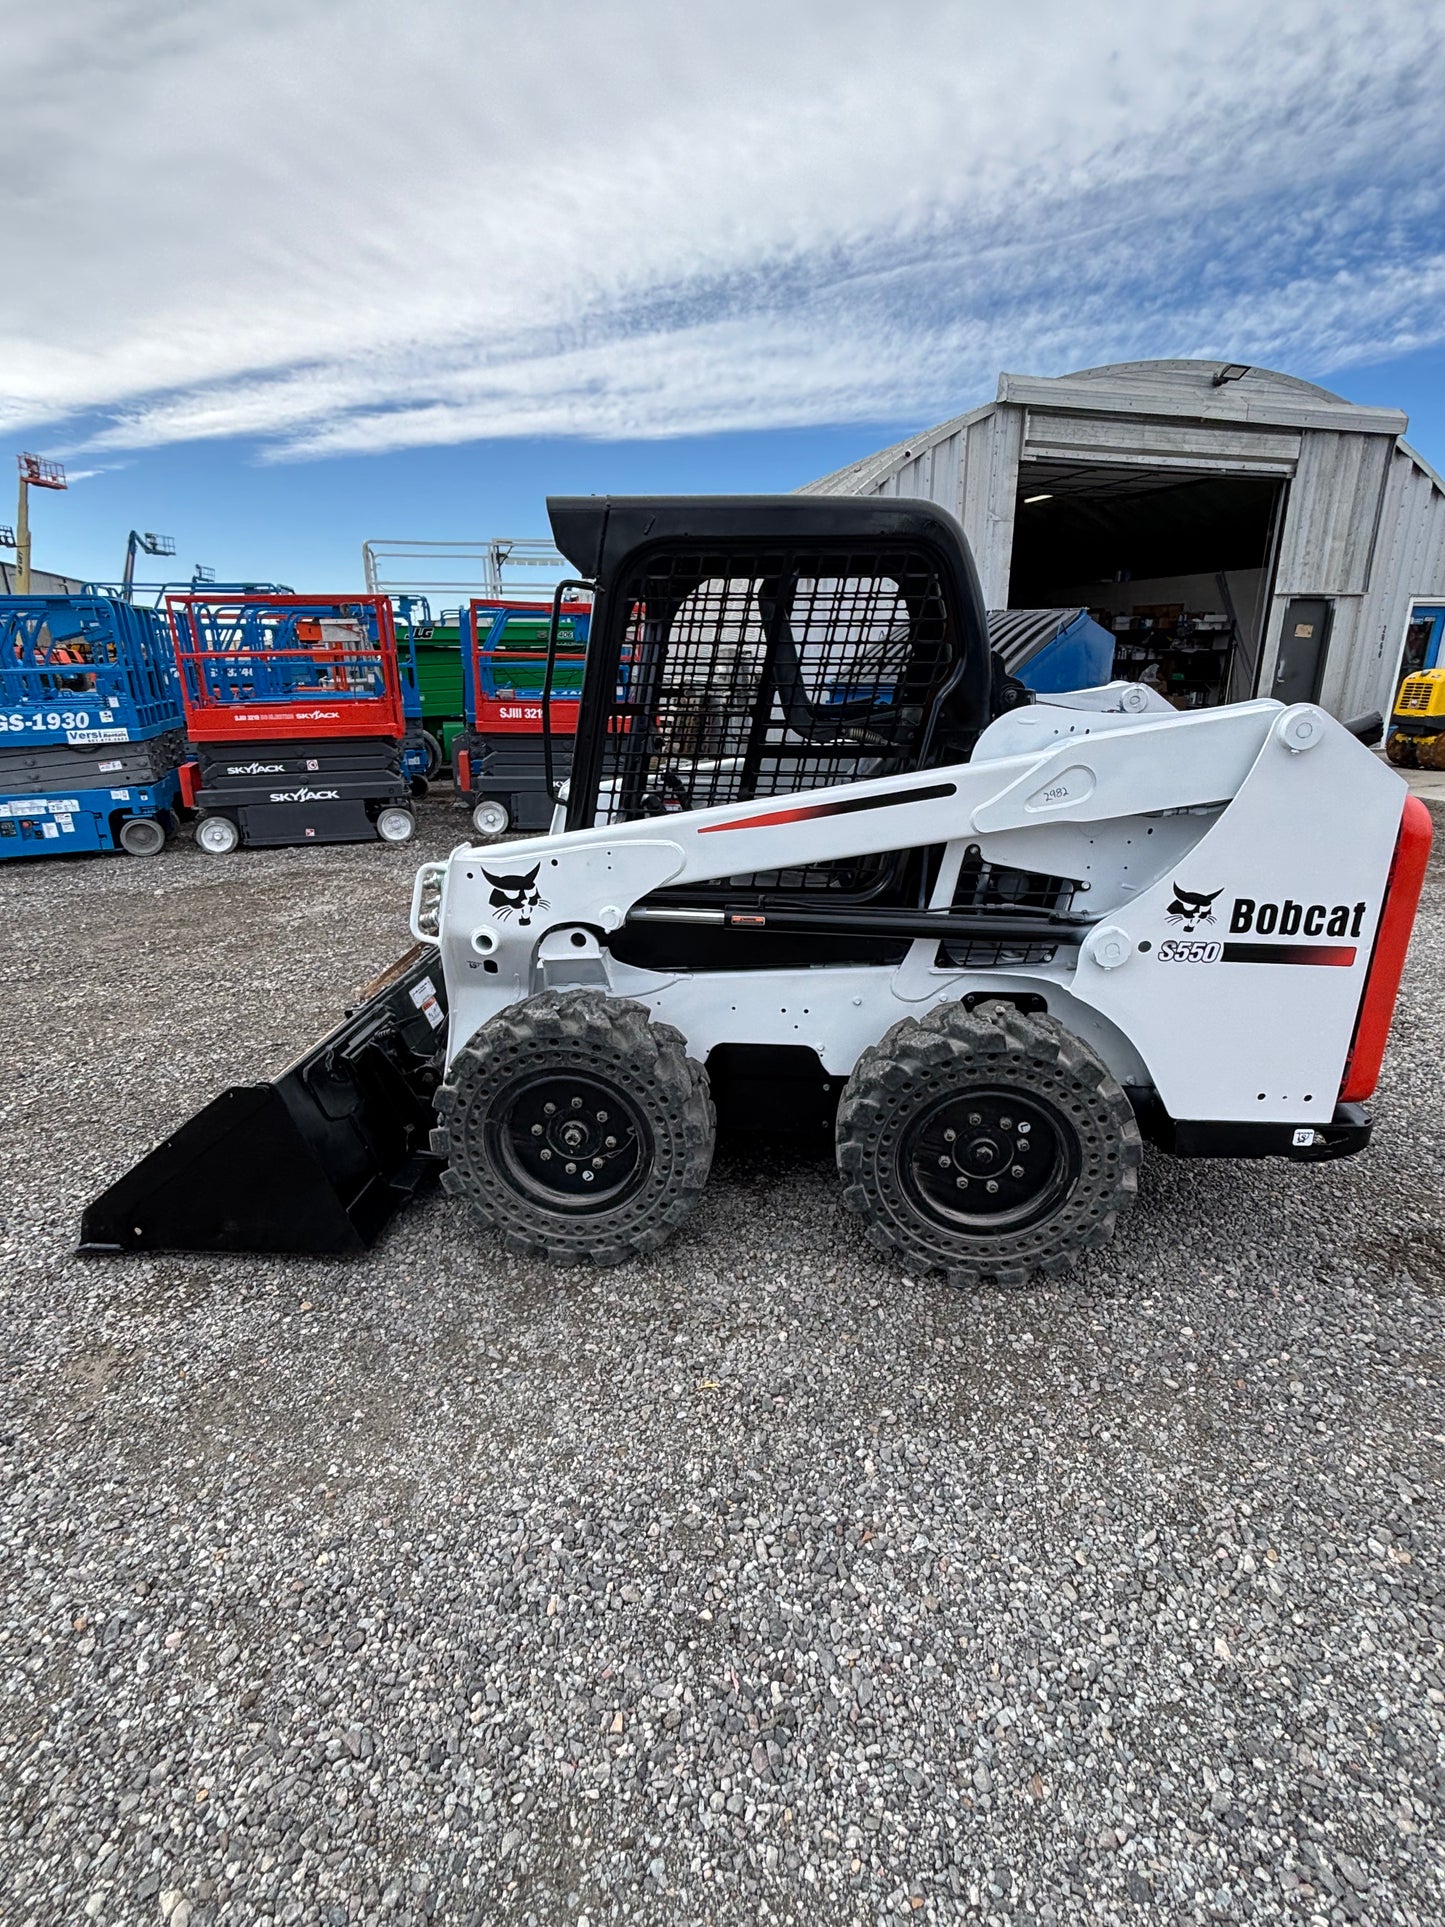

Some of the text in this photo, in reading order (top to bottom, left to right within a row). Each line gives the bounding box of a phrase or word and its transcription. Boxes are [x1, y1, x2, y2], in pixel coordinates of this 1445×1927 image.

[295, 710, 340, 720] SKYJACK
[524, 708, 543, 719] 321
[227, 762, 286, 774] SKYJACK
[269, 787, 340, 802] SKYJACK
[1043, 787, 1070, 802] 2982
[1229, 898, 1366, 938] Bobcat
[1157, 940, 1221, 963] S550
